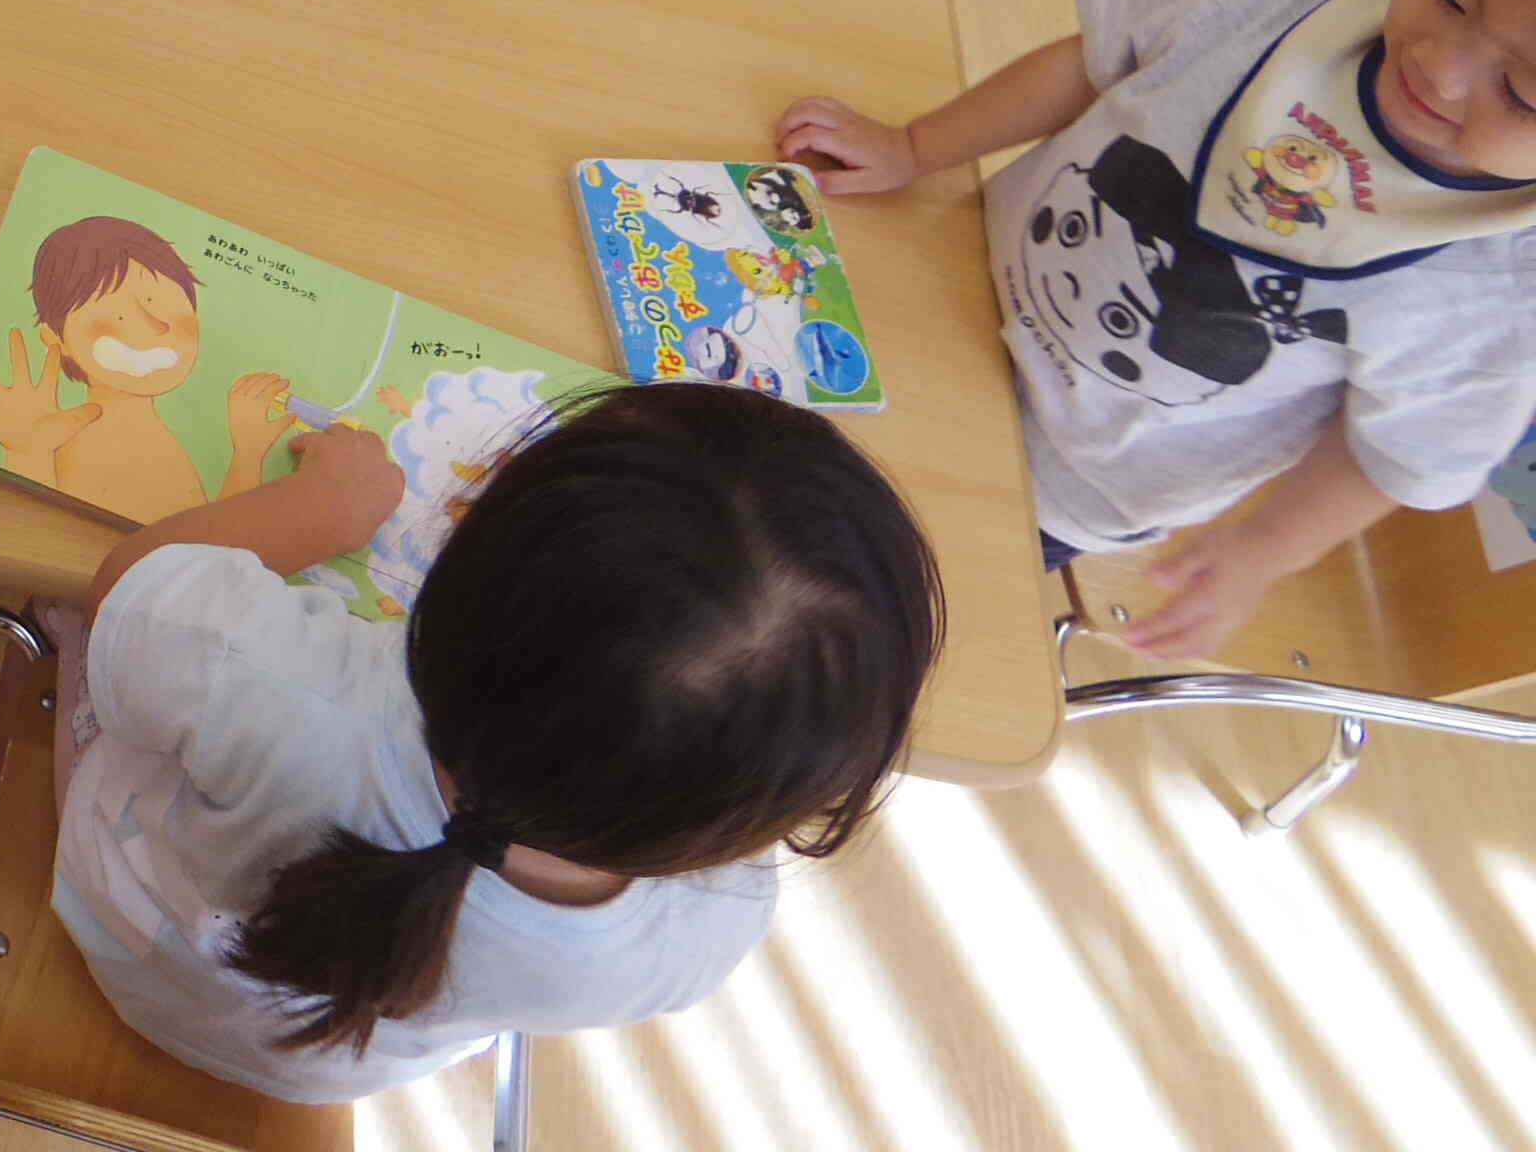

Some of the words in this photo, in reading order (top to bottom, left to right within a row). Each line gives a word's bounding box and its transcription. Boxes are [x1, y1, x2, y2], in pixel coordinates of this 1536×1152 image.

[207, 234, 249, 257] あわあわ
[257, 254, 296, 276] いっぱい
[263, 272, 318, 303] なっちゃった
[664, 244, 709, 321] ずかん
[410, 340, 481, 360] がおーっ！
